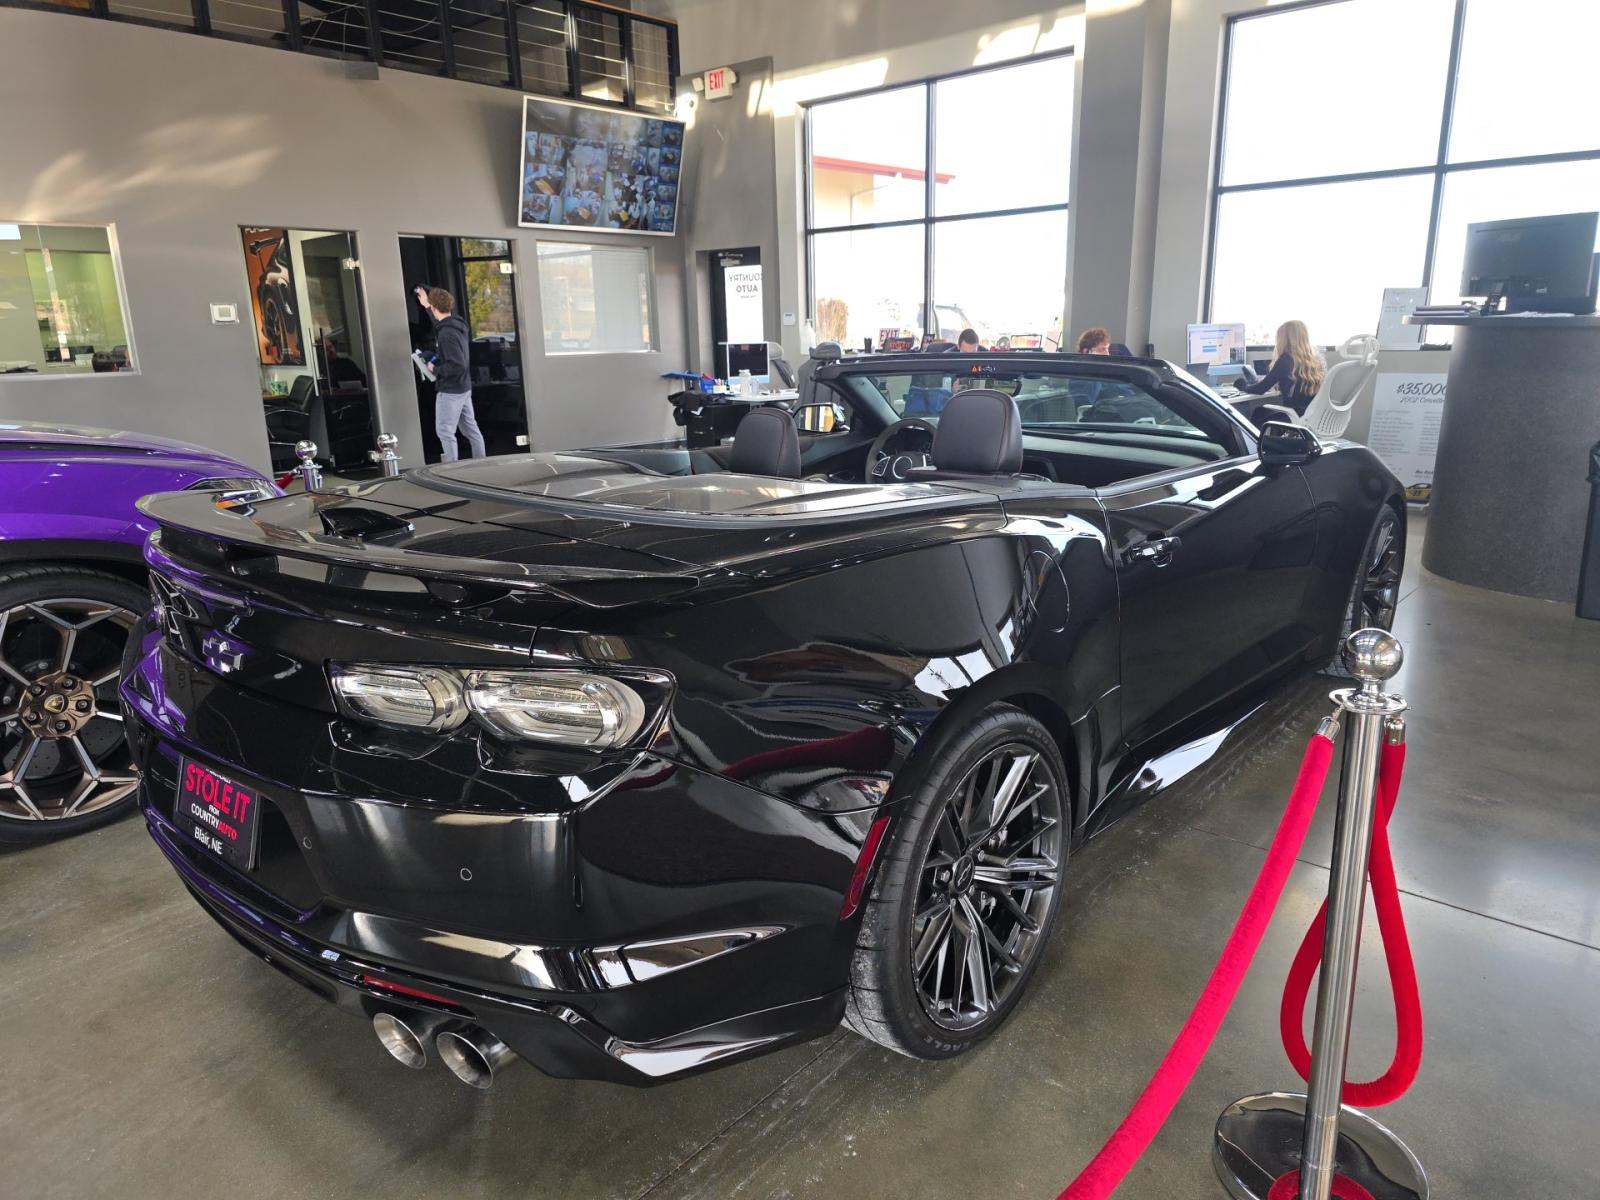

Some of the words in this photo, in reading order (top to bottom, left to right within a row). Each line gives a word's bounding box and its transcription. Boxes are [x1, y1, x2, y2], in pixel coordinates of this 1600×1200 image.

[709, 69, 724, 90] EXIT
[186, 763, 233, 814] STOLE
[233, 791, 251, 824] IT
[194, 826, 211, 849] Blair,
[211, 837, 223, 855] NE
